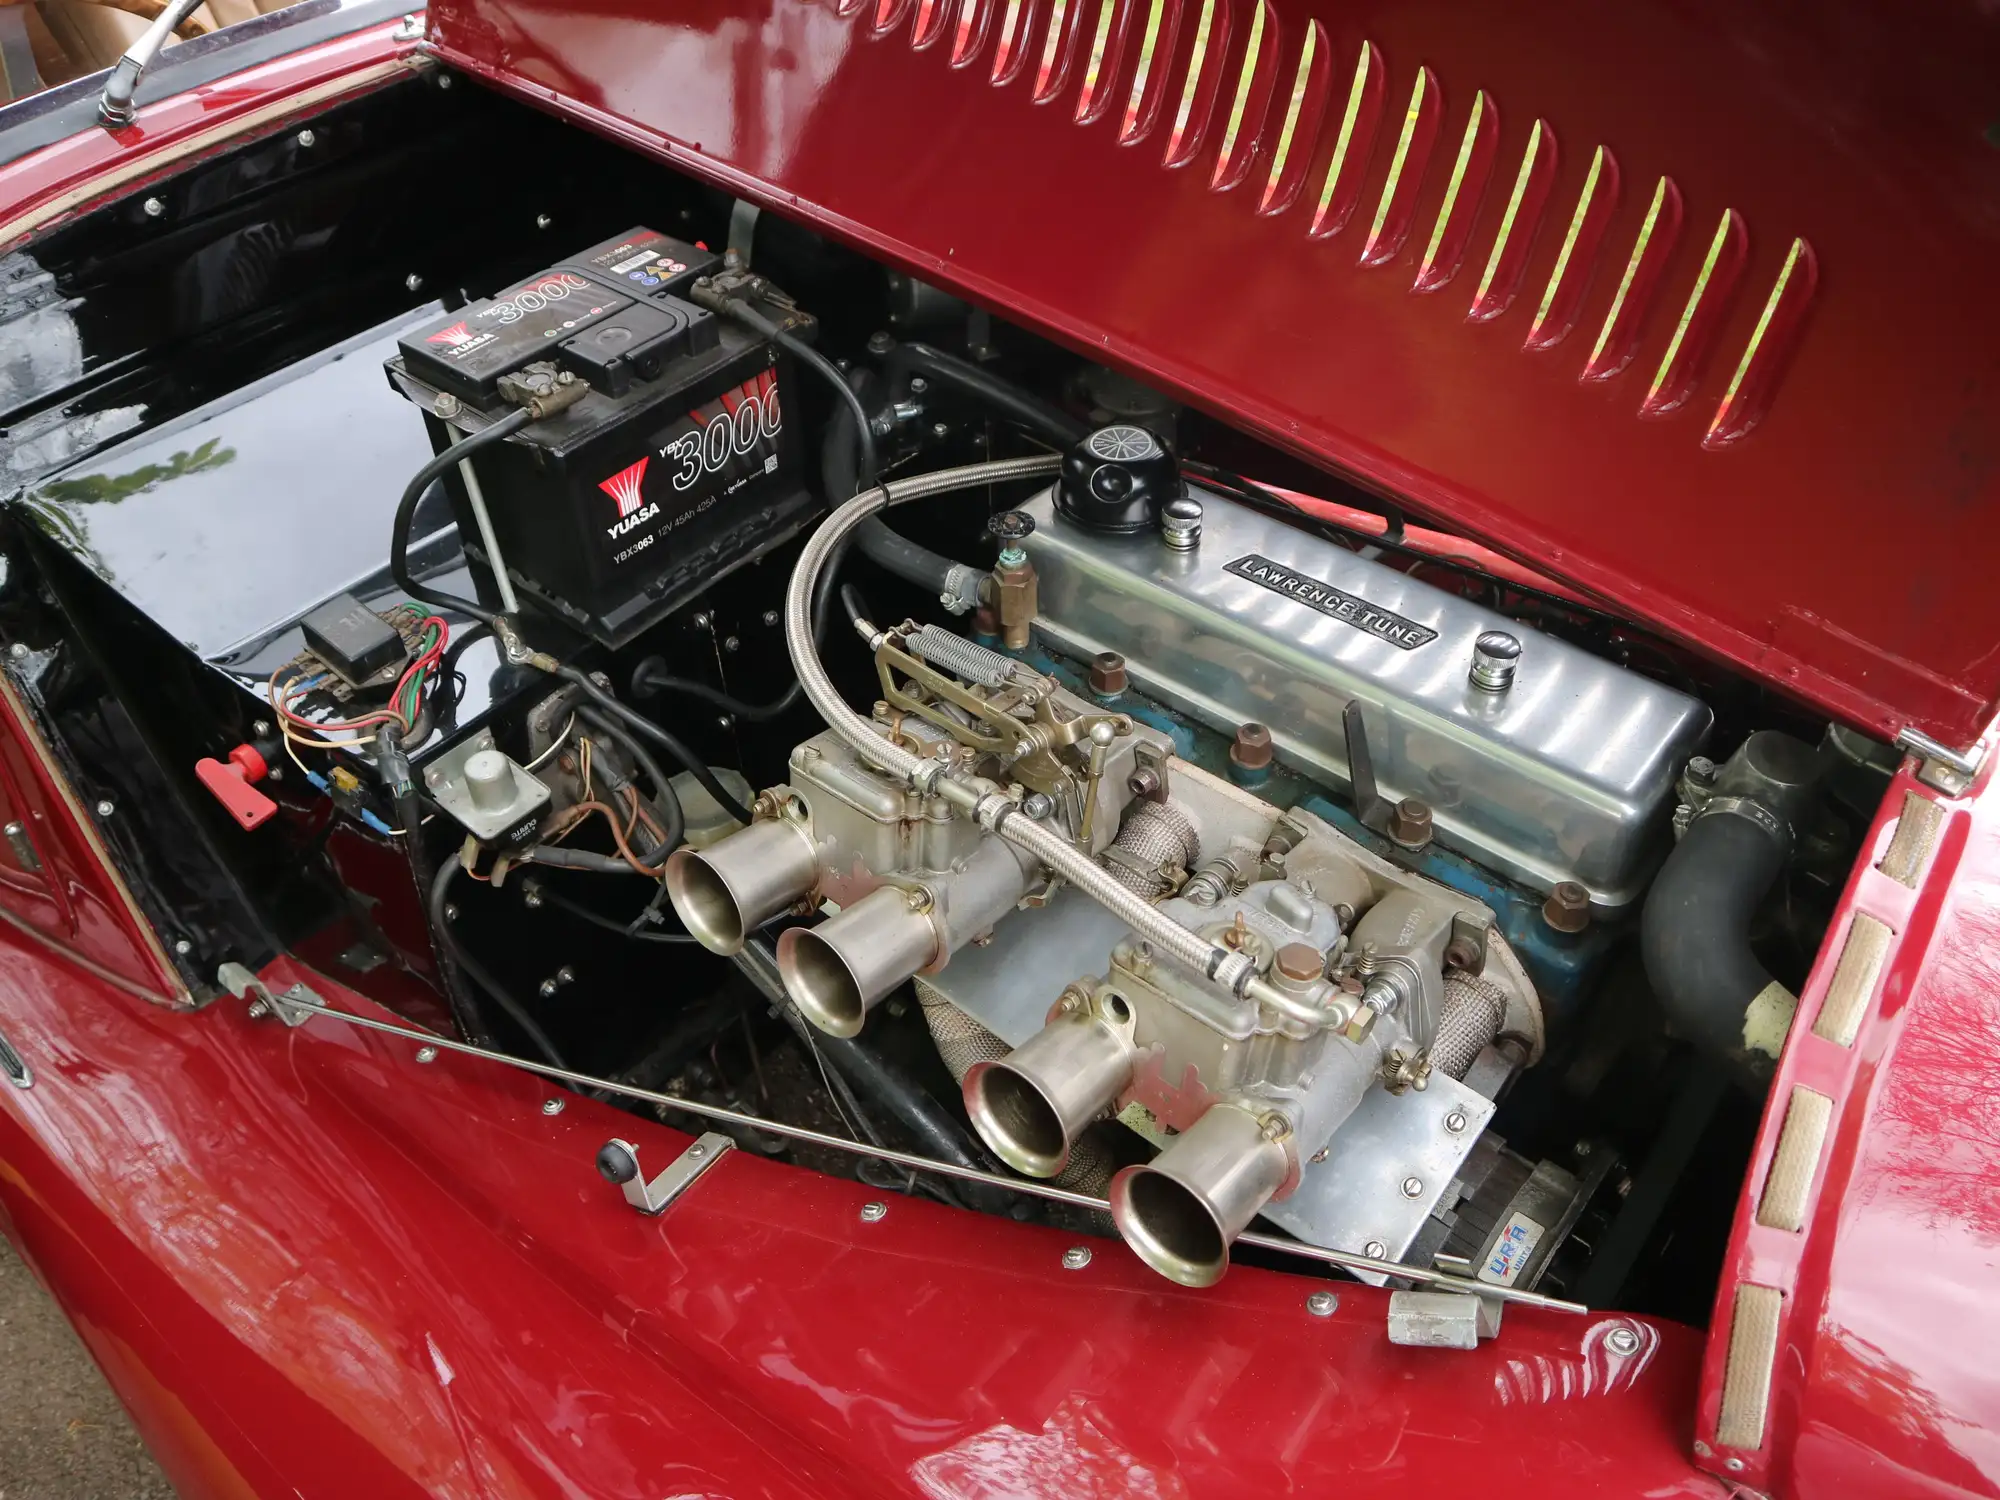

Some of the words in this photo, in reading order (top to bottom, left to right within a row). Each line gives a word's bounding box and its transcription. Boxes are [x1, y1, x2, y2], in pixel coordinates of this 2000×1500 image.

[447, 333, 495, 356] YUASA
[659, 439, 683, 458] YBX
[607, 502, 660, 540] YUASA
[613, 534, 655, 564] YBX3063
[658, 521, 673, 537] 12V
[674, 509, 695, 527] 45Ah
[1239, 559, 1355, 616] LAWRENCE
[1360, 610, 1421, 646] TUNE
